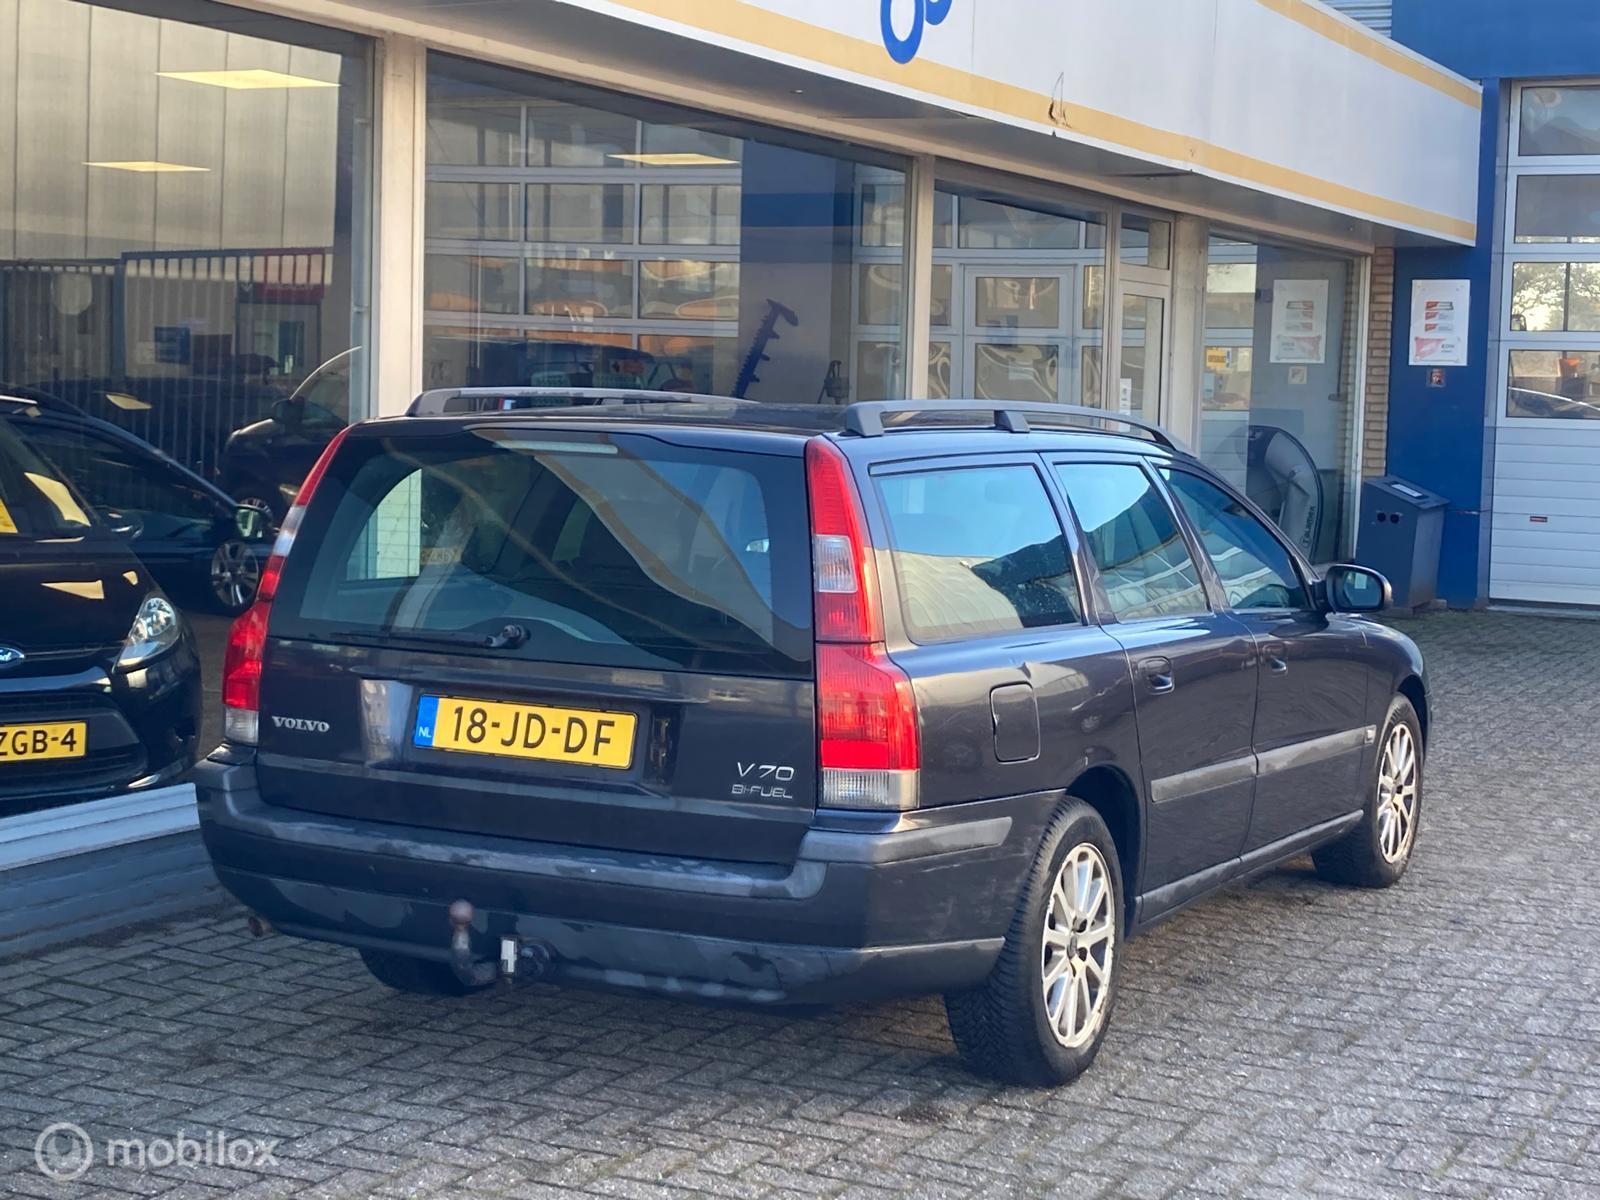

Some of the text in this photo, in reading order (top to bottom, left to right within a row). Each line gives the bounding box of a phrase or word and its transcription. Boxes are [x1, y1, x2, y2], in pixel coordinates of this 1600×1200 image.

[272, 715, 330, 732] VOLVO
[454, 706, 615, 756] 18-JD-DF
[419, 727, 431, 738] NL
